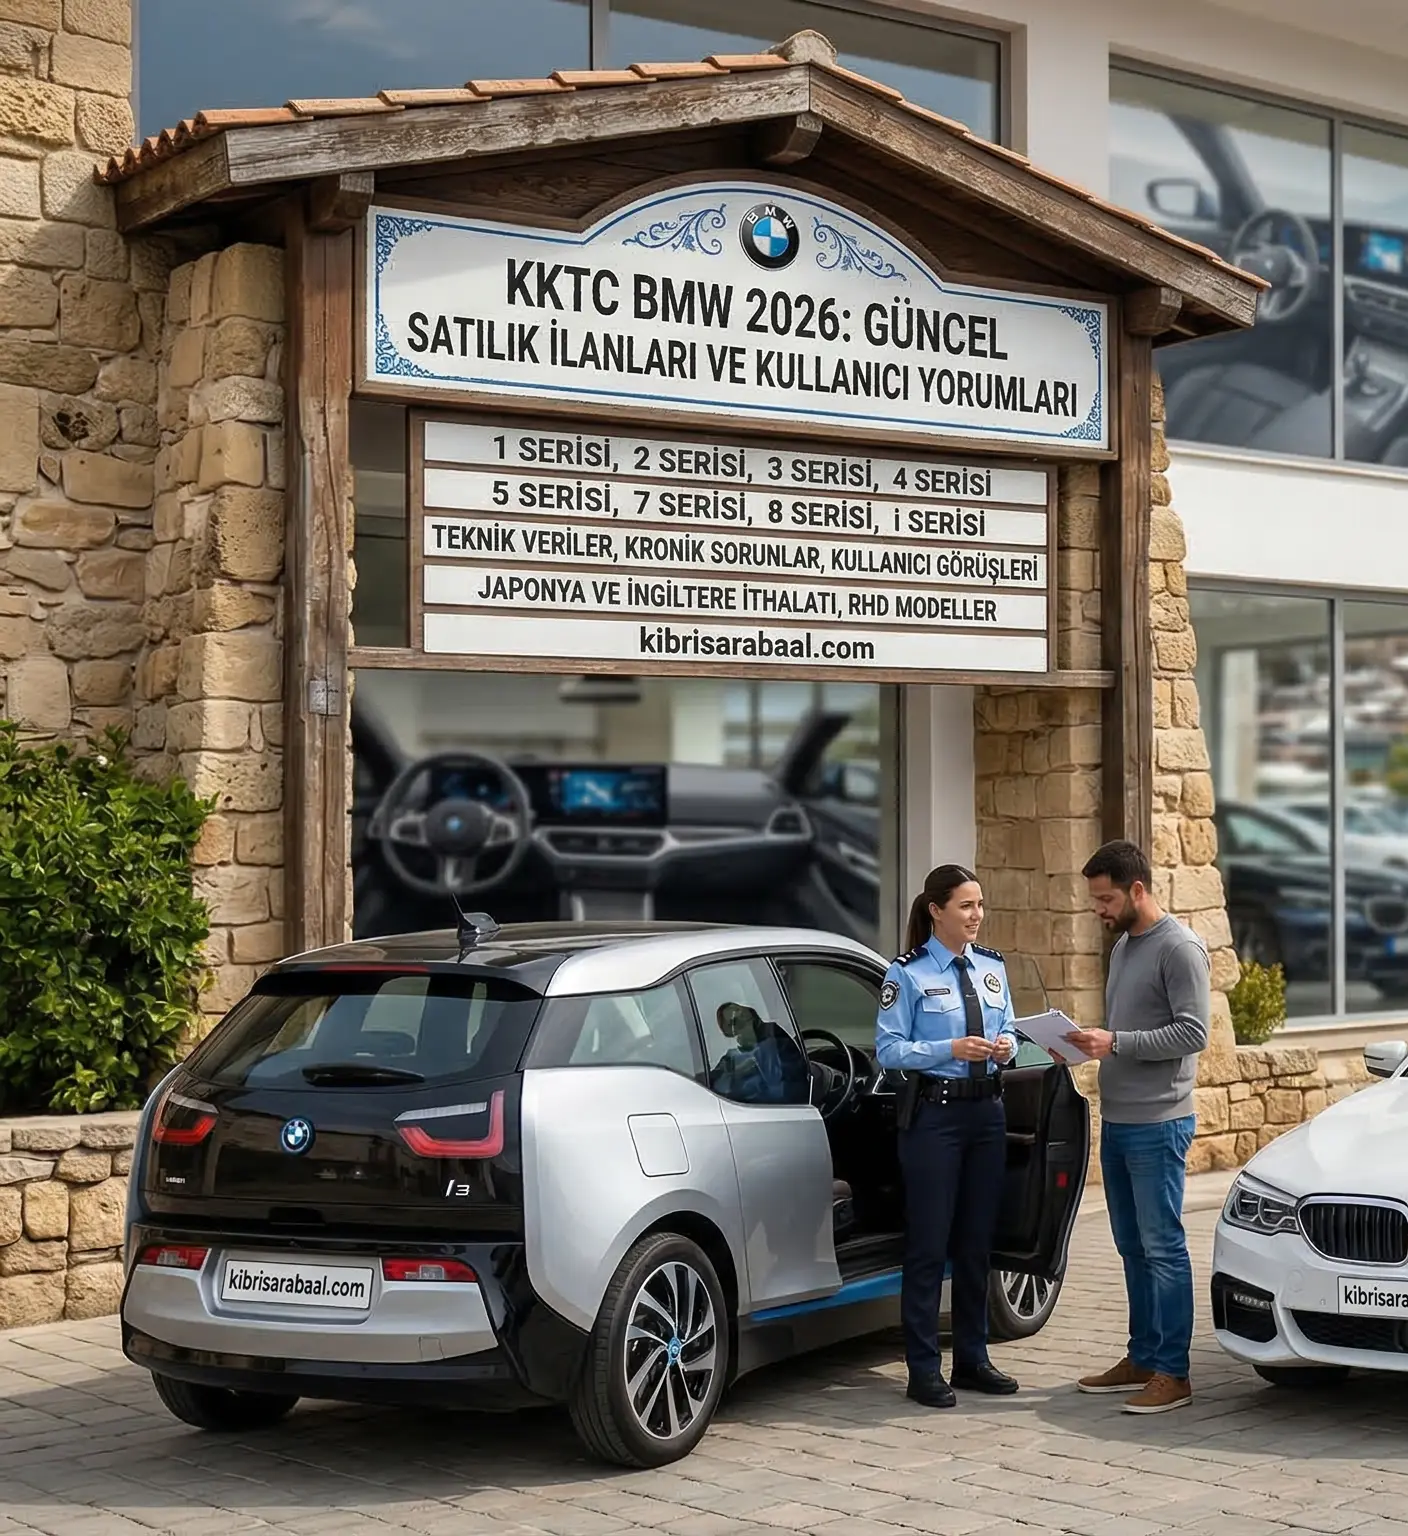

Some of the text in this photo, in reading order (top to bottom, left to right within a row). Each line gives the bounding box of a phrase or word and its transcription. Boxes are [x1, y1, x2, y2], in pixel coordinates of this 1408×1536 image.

[747, 206, 795, 230] BMW
[508, 259, 1008, 360] KKTC BMW 2026: GÜNCEL
[408, 315, 1076, 417] SATILIK İLANLARI VE KULLANICI YORUMLARI
[494, 435, 990, 496] 1 SERİSİ, 2 SERİSİ, 3 SERİSİ, 4 SERİSİ
[493, 481, 984, 536] 5 SERİSİ, 7 SERİSİ, 8 SERİSİ, i SERİSİ
[432, 522, 1038, 585] TEKNİK VERİLER, KRONİK SORUNLAR, KULLANICI GÖRÜŞLERİ
[478, 576, 996, 621] JAPONYA VE İNGİLTERE İTHALATI, RHD MODELLER
[641, 626, 874, 659] kibrisarabaal.com
[228, 1269, 365, 1298] kibrisarabaal.com
